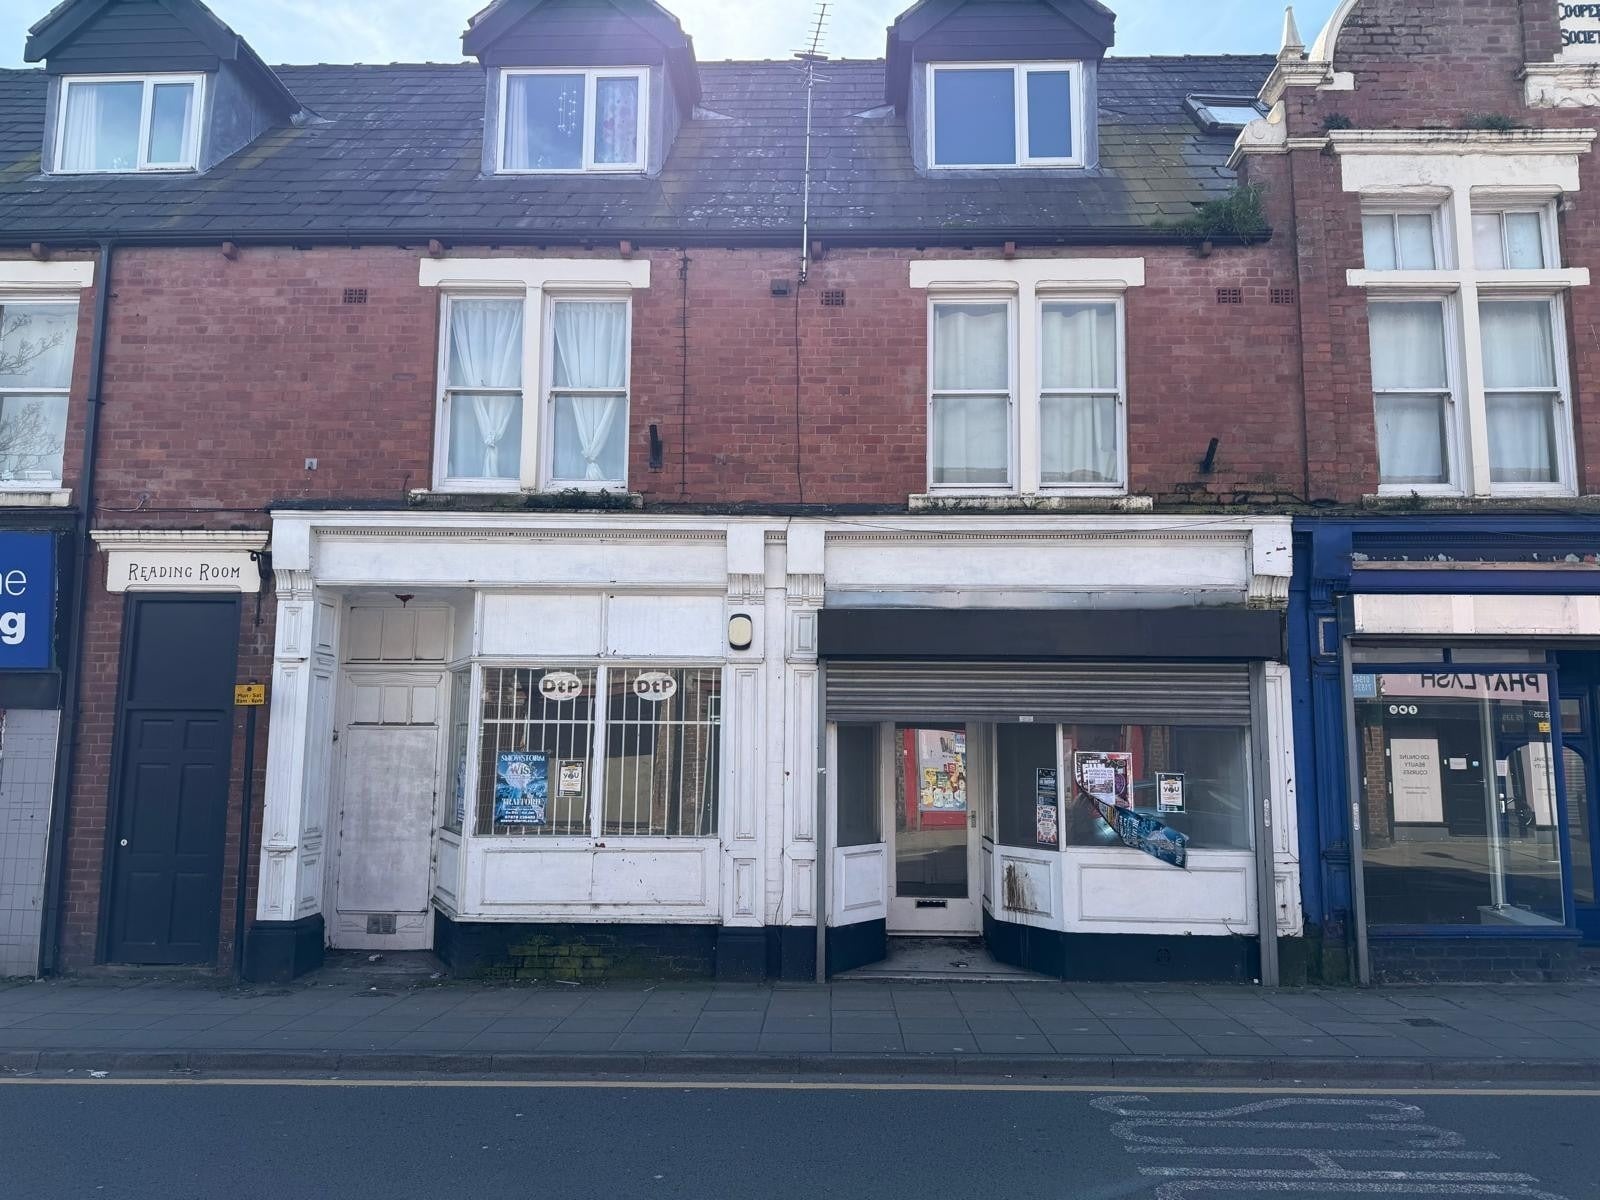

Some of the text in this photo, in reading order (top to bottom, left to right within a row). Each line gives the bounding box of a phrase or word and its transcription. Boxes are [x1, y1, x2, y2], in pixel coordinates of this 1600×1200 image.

[128, 563, 240, 581] READING ROOM
[0, 570, 27, 596] e
[0, 611, 26, 645] g
[542, 679, 580, 693] DtP
[637, 680, 674, 693] DtP
